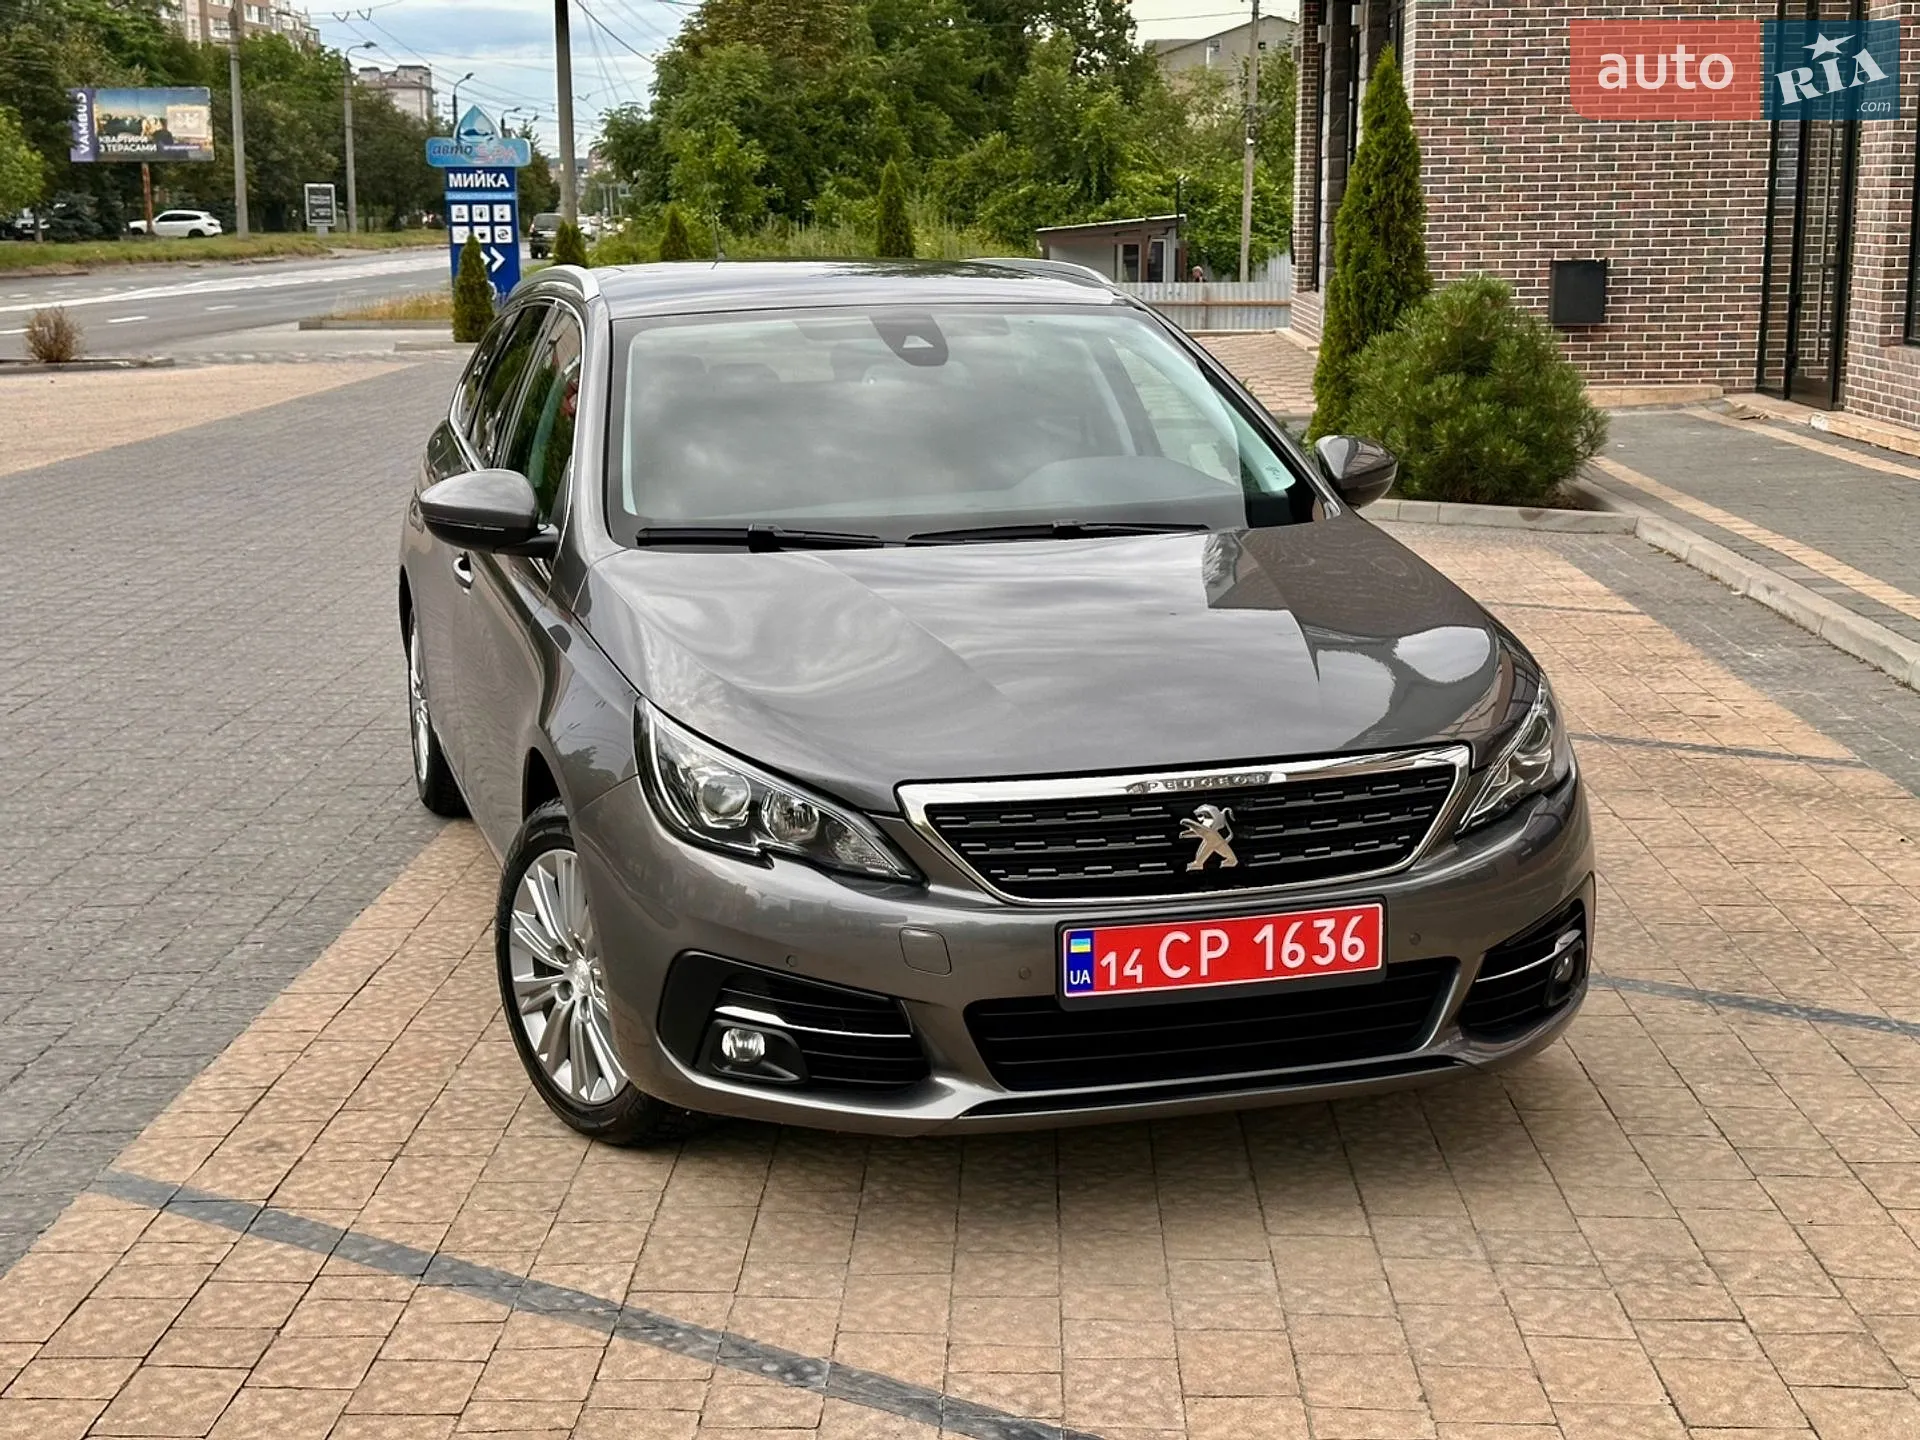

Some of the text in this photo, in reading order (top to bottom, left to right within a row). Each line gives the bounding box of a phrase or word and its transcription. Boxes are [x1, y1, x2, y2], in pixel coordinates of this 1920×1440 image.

[77, 92, 90, 154] VAMBUD
[107, 144, 157, 152] ТЕРАСАМИ
[432, 144, 473, 156] авто
[448, 169, 510, 188] МИЙКА
[1100, 915, 1366, 986] 14 CP 1636
[1070, 969, 1091, 986] UA
